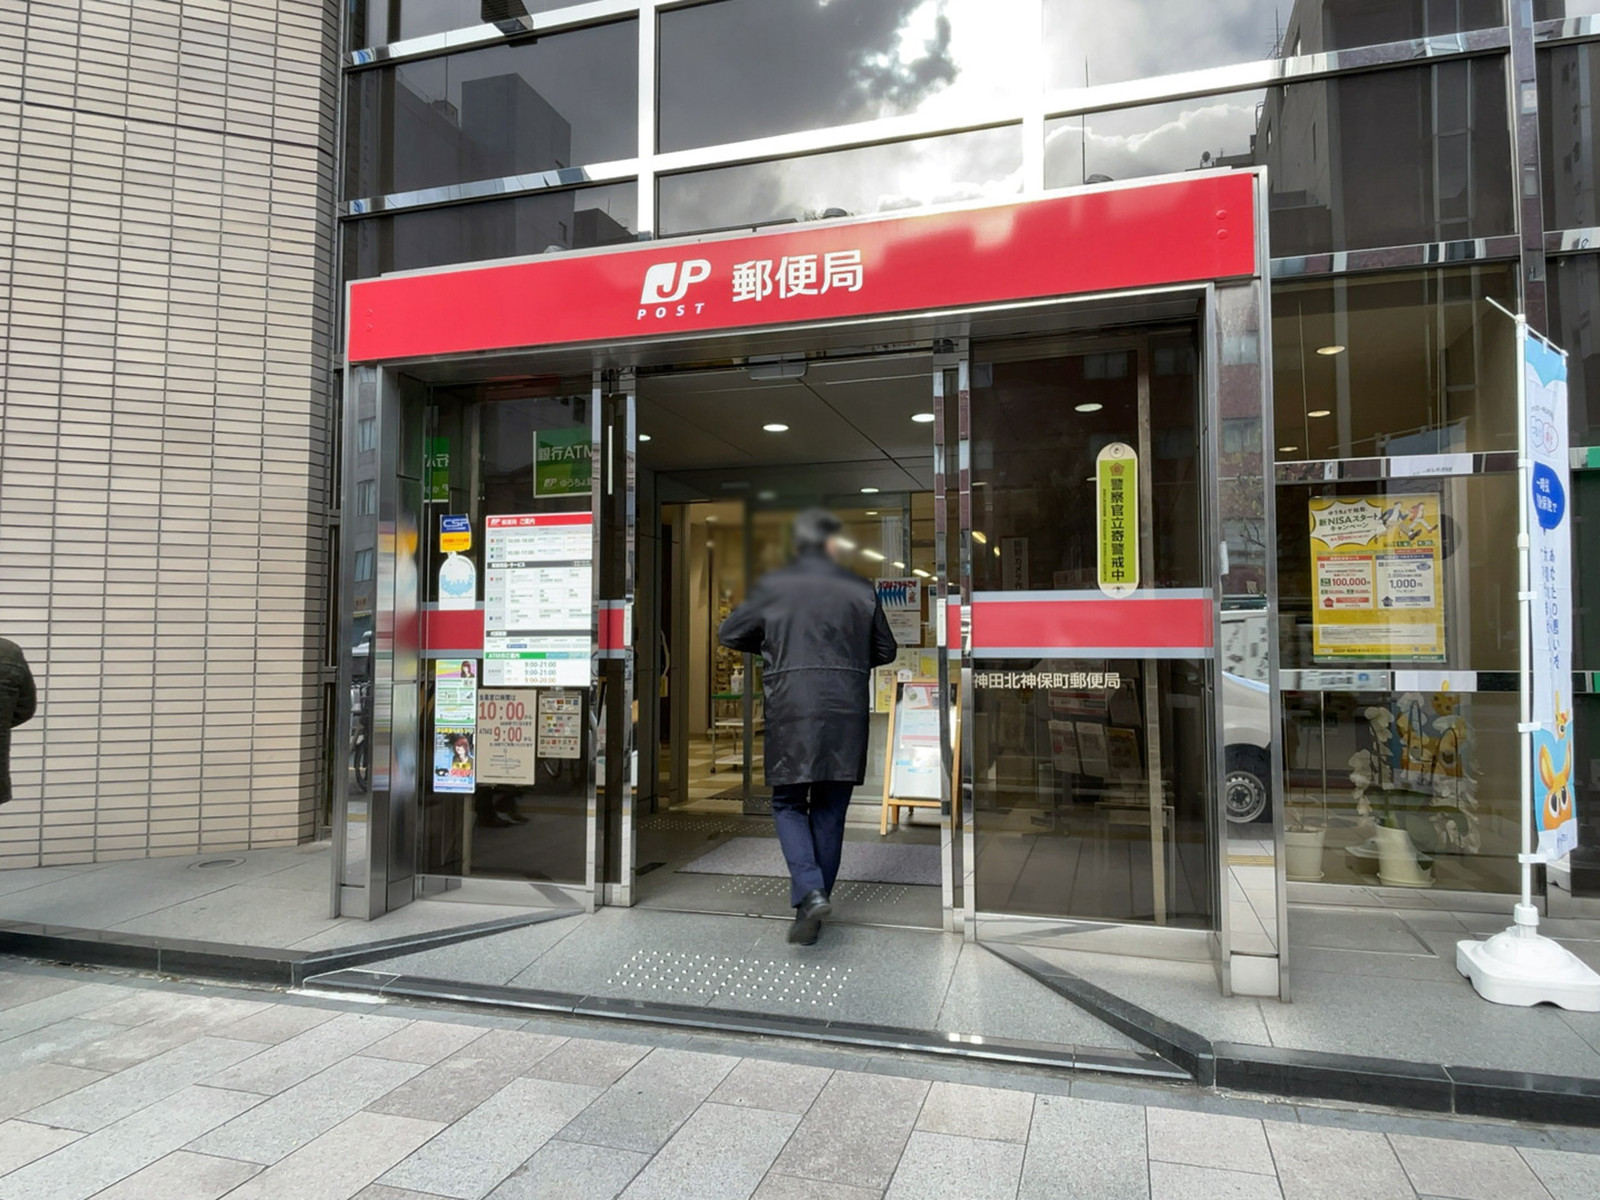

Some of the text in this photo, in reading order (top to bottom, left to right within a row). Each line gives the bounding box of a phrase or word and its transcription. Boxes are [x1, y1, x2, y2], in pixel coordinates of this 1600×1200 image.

[640, 249, 863, 305] JP 郵便局
[637, 303, 705, 321] POST
[443, 518, 469, 528] CSP
[1319, 512, 1379, 527] 新NISAスタート
[1331, 522, 1369, 532] キャンペーン
[1110, 478, 1125, 582] 警察官立寄警戒中
[974, 672, 1121, 690] 神田北神保町郵便局
